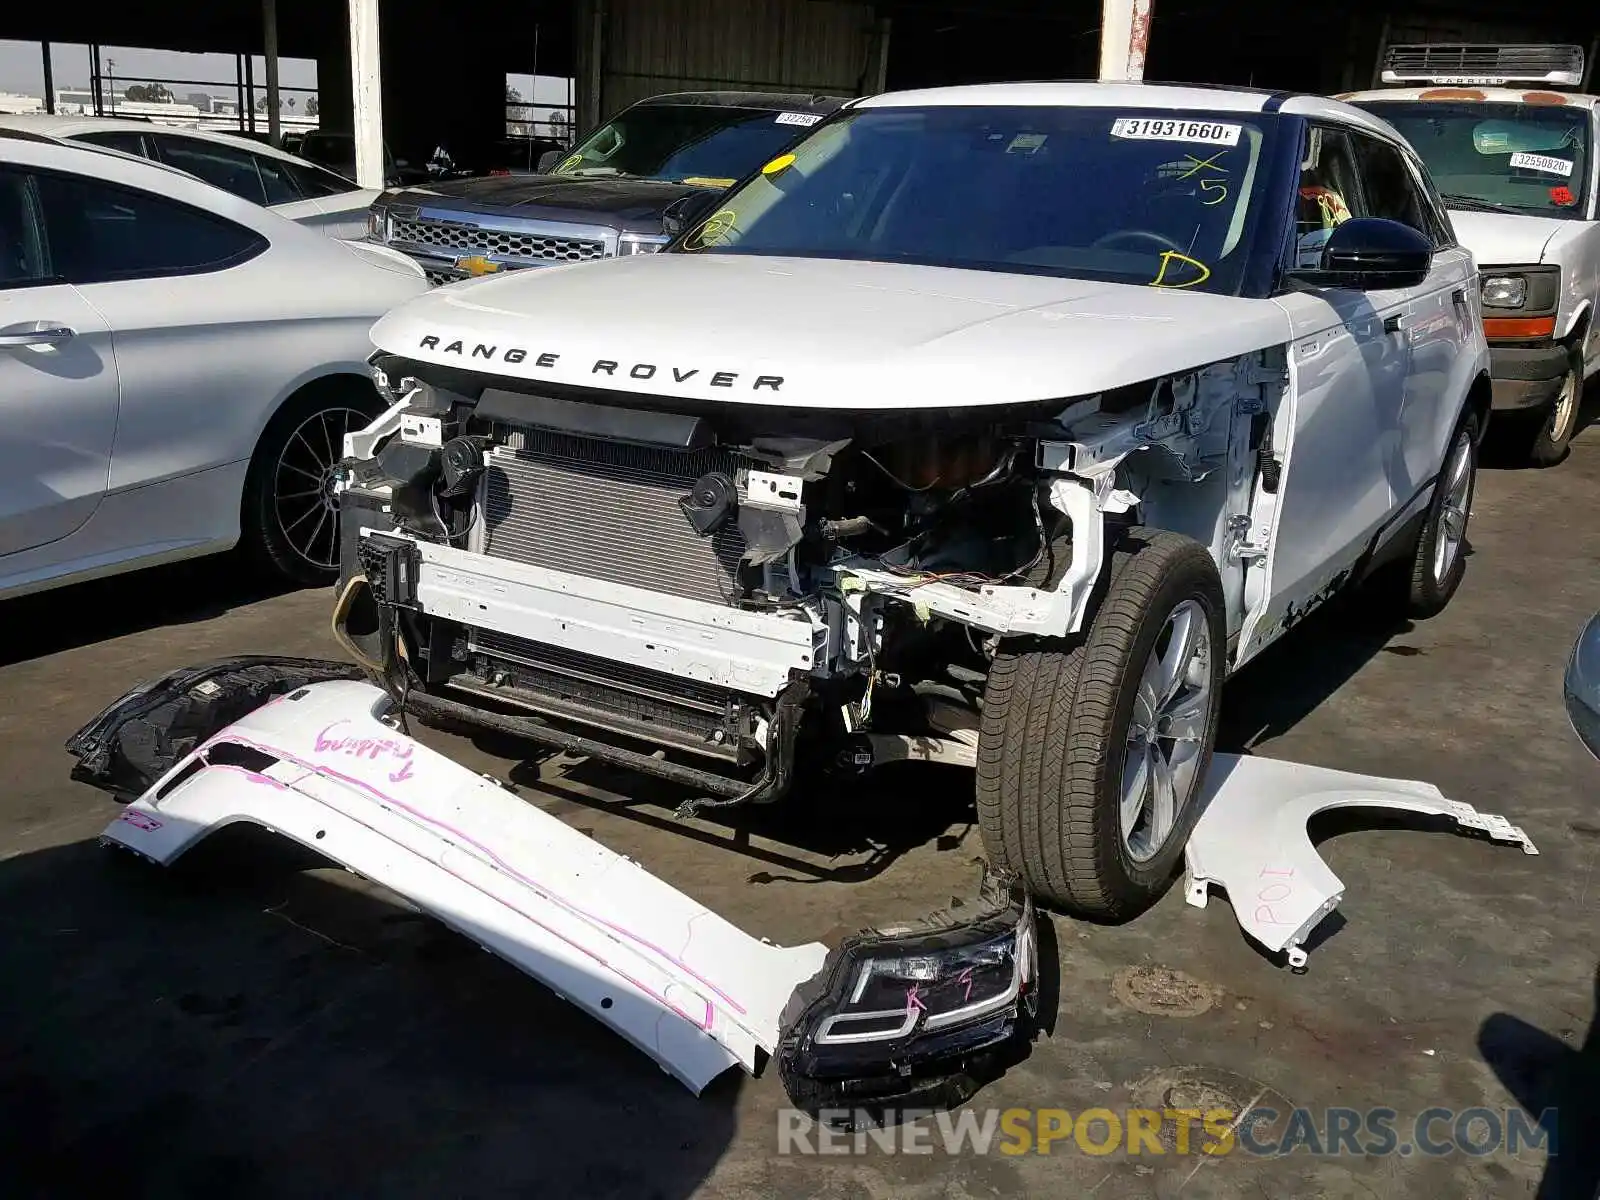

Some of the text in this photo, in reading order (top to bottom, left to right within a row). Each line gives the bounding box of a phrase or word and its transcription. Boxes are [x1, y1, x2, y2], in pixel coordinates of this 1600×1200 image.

[1200, 178, 1228, 206] 5
[1149, 250, 1211, 289] D
[419, 335, 785, 392] RANGE ROVER
